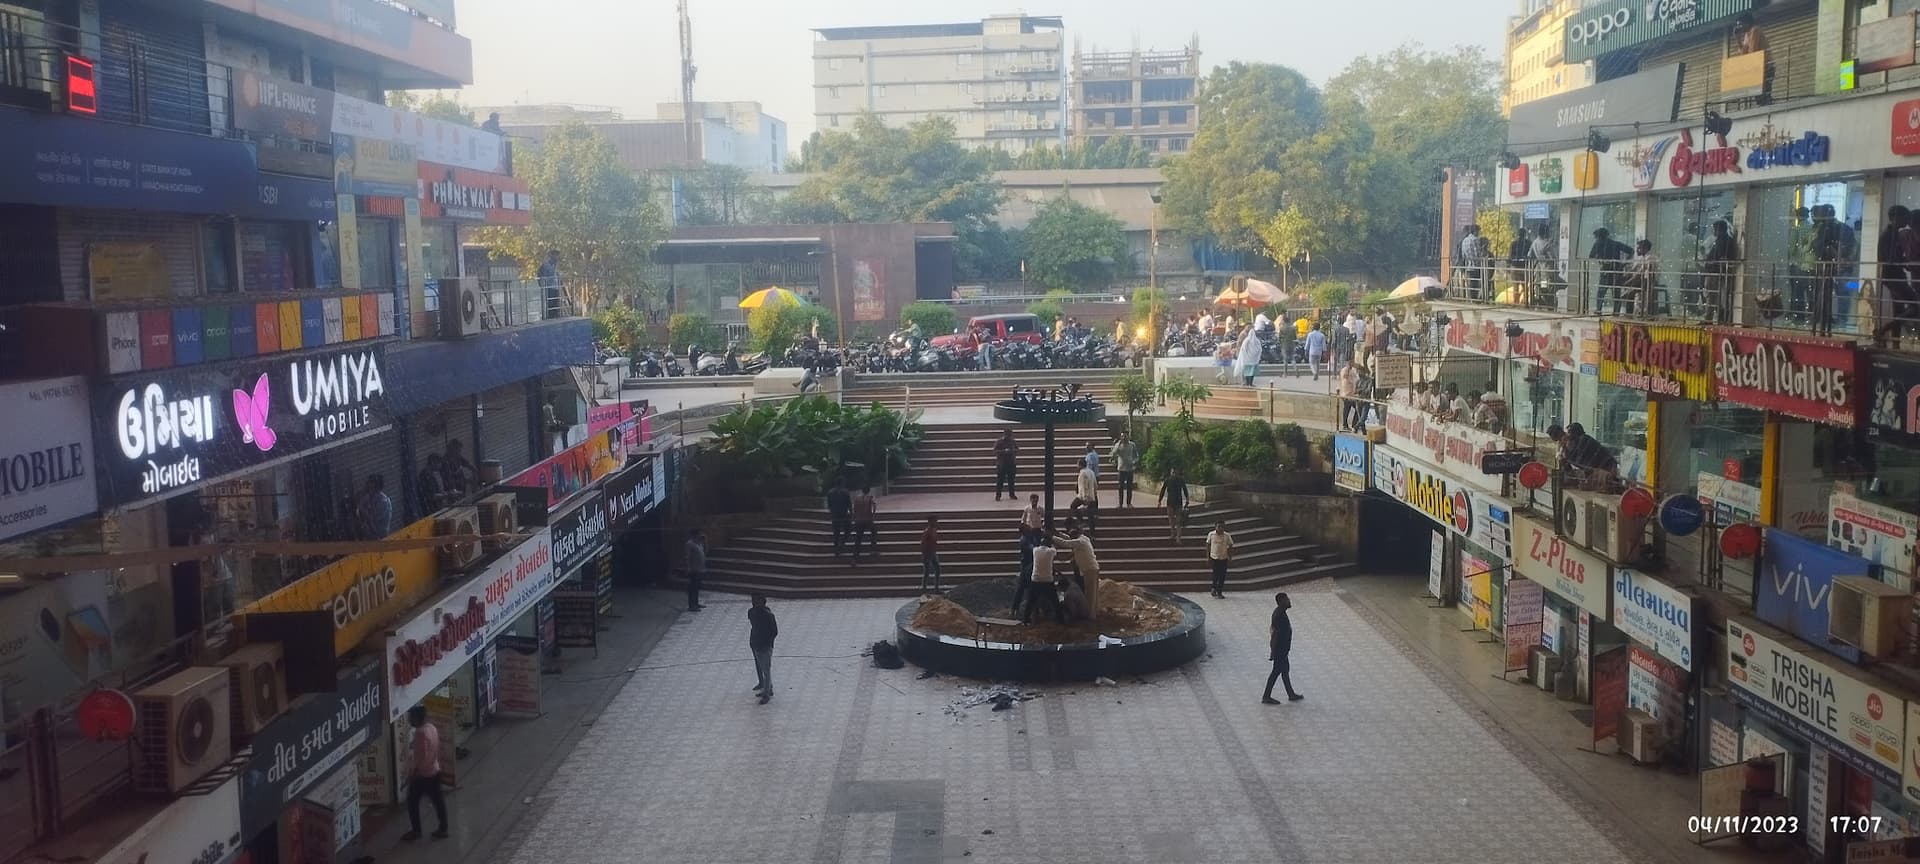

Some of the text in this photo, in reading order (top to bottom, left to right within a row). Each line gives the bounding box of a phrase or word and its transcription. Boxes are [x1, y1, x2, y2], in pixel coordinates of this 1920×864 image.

[1570, 7, 1630, 45] oppo
[1557, 99, 1605, 127] SAMSUNG
[1895, 133, 1920, 145] moto
[263, 184, 279, 204] SBI
[177, 332, 200, 344] vivo
[290, 351, 384, 416] UMIYA
[1773, 344, 1846, 406] વિનાયક
[117, 382, 214, 460] ઉમિયા
[314, 406, 370, 440] MOBILE
[1335, 447, 1362, 467] vivo
[1406, 467, 1452, 525] Mobile
[1530, 529, 1585, 585] Z-Plus
[1616, 570, 1690, 633] નીલમાધવ
[1773, 562, 1834, 614] viv
[1771, 649, 1836, 703] TRISHA
[1771, 677, 1838, 733] MOBILE
[1867, 700, 1881, 715] Jio
[267, 742, 298, 785] નીલ
[301, 720, 333, 766] કમલ
[336, 681, 381, 731] મોબાઈલ
